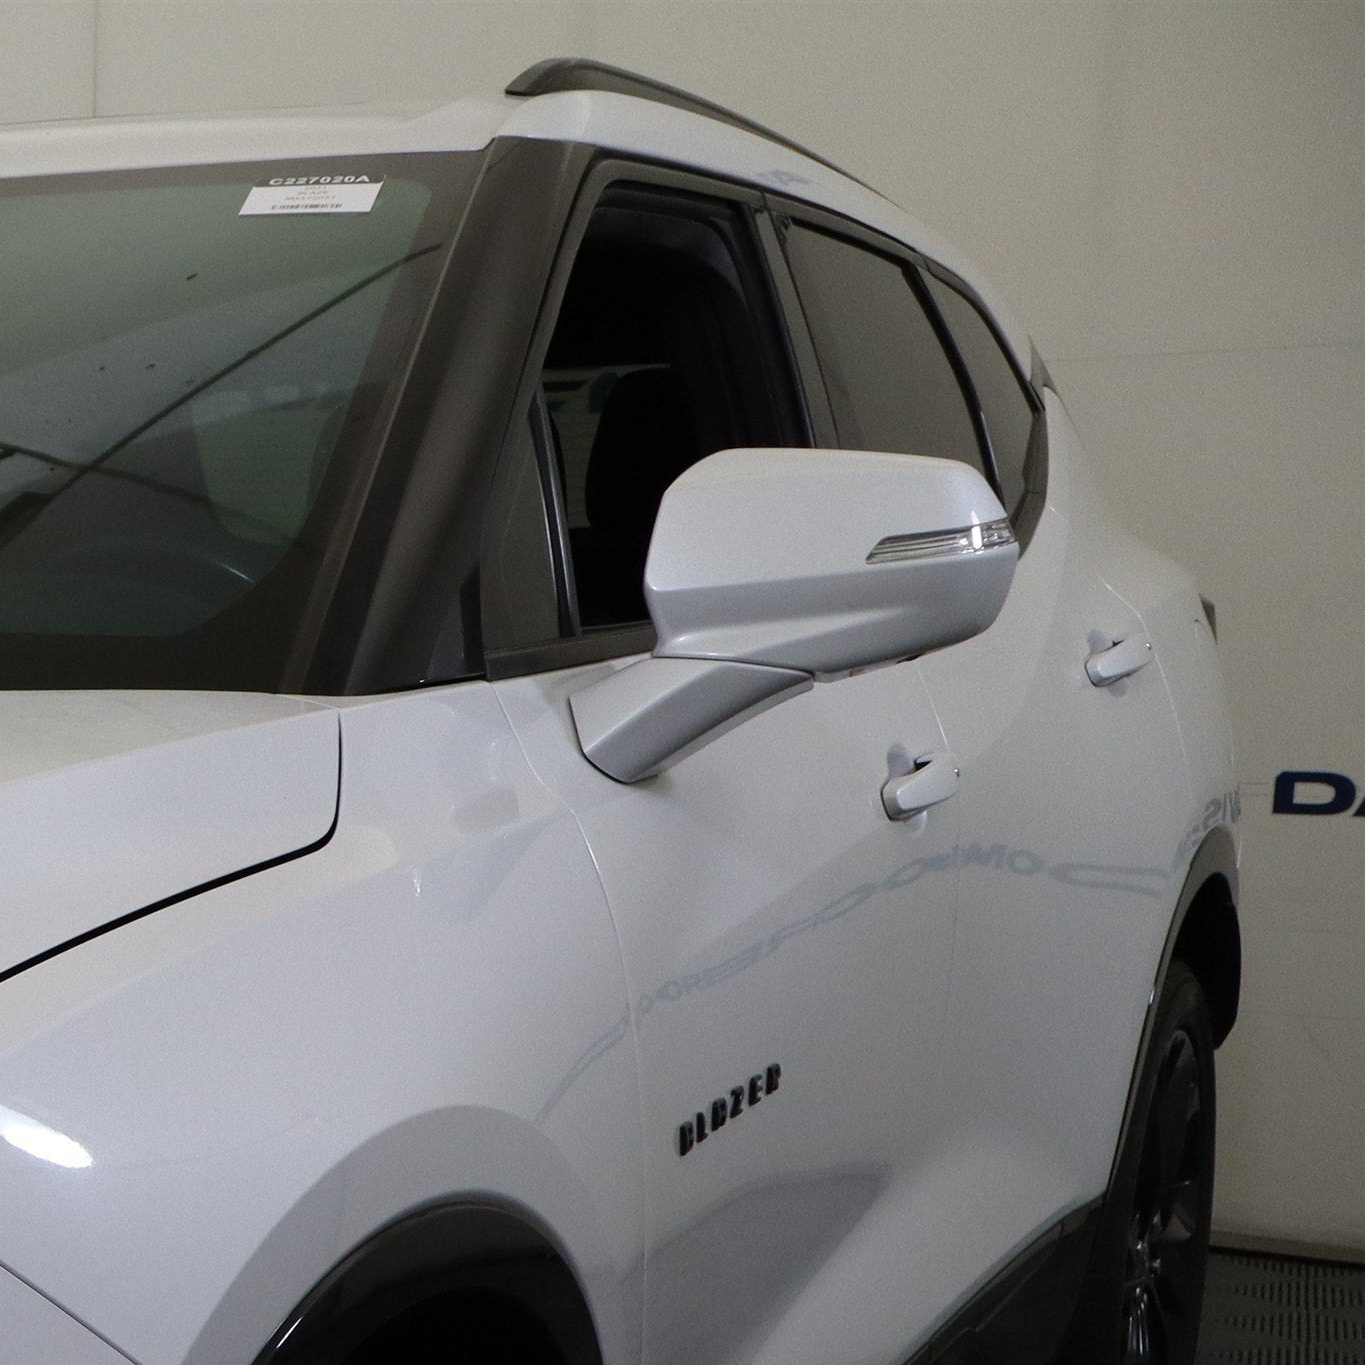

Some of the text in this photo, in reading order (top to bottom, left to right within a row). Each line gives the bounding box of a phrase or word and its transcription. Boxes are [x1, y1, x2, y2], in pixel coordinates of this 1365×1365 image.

[268, 174, 370, 186] C227020A
[1272, 770, 1365, 818] D
[676, 1062, 782, 1157] BLAZER
